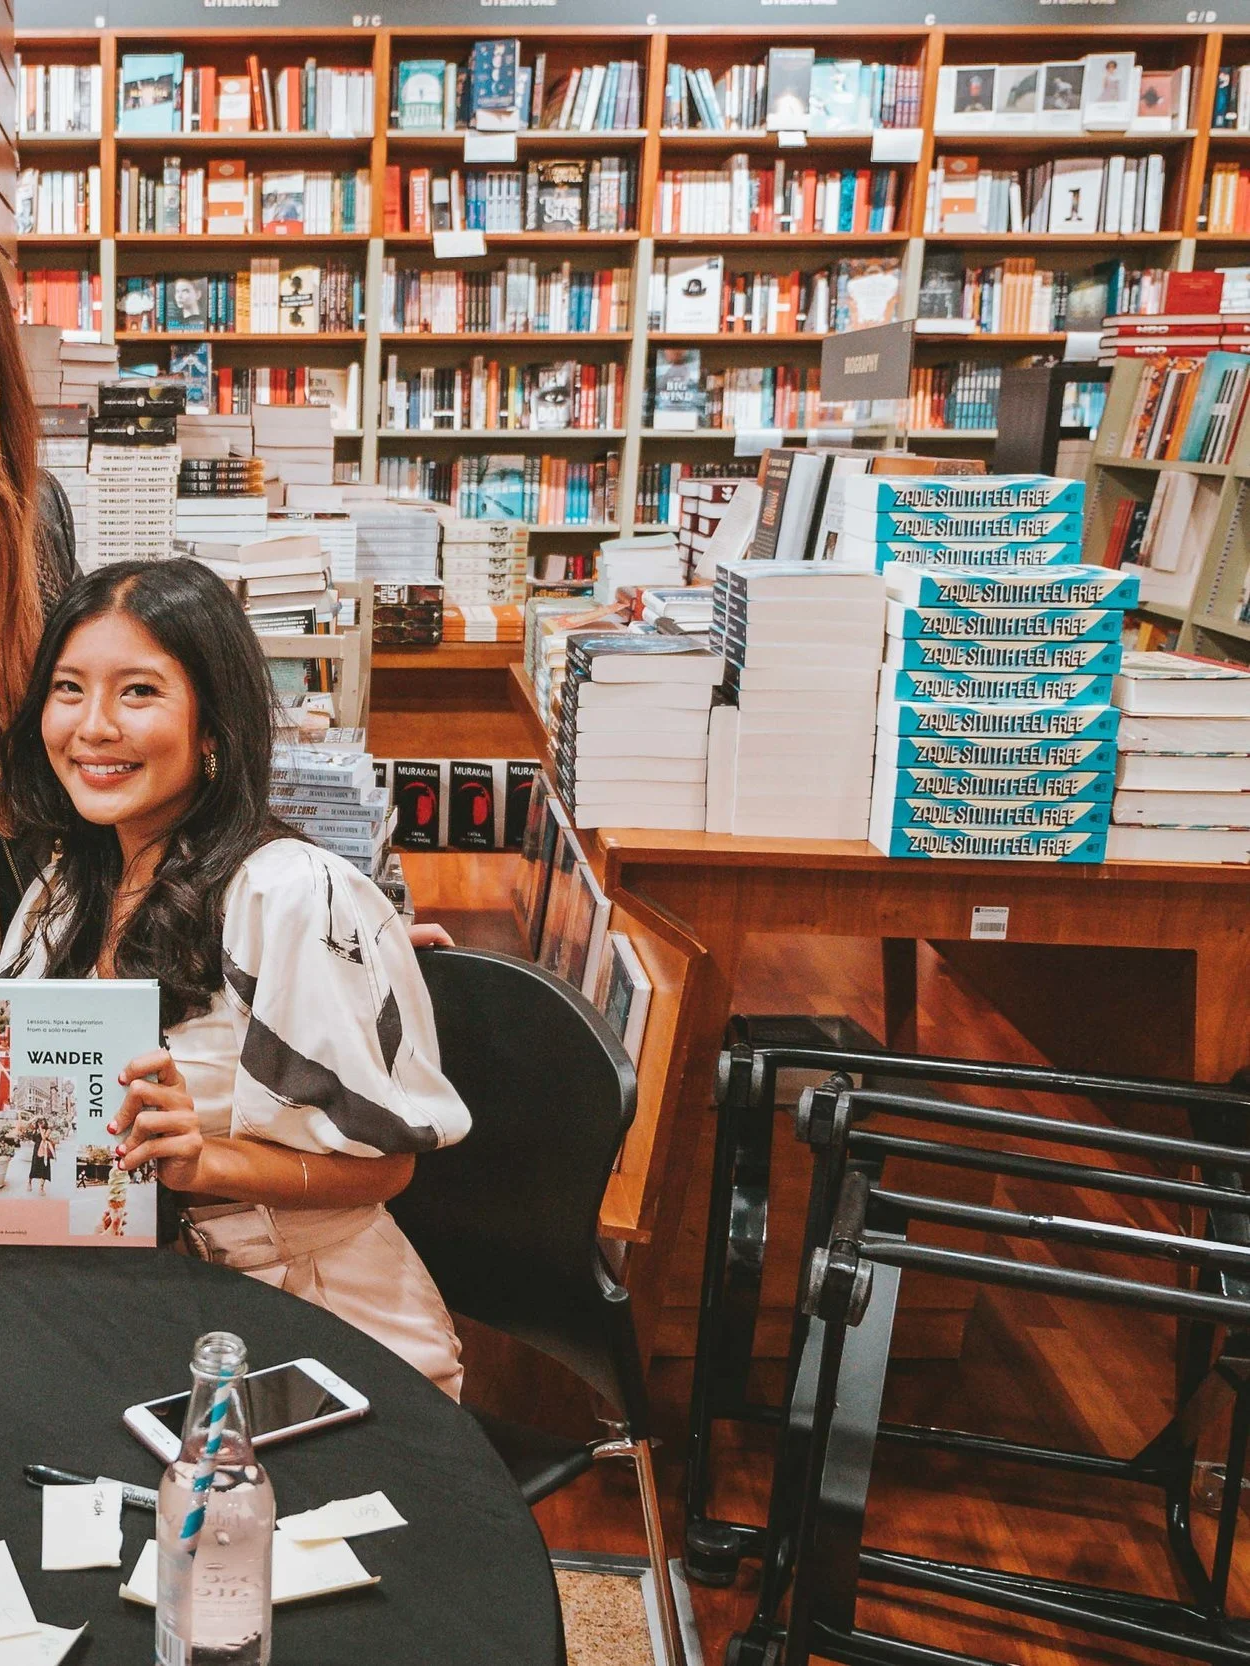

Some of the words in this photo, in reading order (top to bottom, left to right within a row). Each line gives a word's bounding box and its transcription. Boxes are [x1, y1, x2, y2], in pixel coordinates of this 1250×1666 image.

[894, 489, 935, 507] ZADIE
[935, 489, 982, 507] SMITH
[984, 489, 1015, 507] FEEL
[1016, 489, 1051, 507] FREE
[894, 519, 934, 536] ZADIE
[935, 519, 982, 536] SMITH
[982, 519, 1014, 536] FEEL
[1016, 519, 1051, 536] FREE
[894, 549, 933, 563] ZADIE
[934, 549, 980, 563] SMITH
[981, 549, 1011, 565] FEEL
[1014, 549, 1047, 565] FREE
[937, 584, 981, 602] ZADIE
[982, 584, 1032, 602] SMITH
[1033, 585, 1066, 603] FEEL
[1068, 585, 1104, 603] FREE
[921, 616, 964, 635] ZADIE
[965, 616, 1014, 635] SMITH
[1016, 617, 1049, 636] FEEL
[1051, 617, 1087, 636] FREE
[921, 648, 964, 665] ZADIE
[965, 648, 1014, 665] SMITH
[1016, 649, 1050, 667] FEEL
[1051, 649, 1087, 667] FREE
[913, 680, 956, 698] ZADIE
[957, 680, 1005, 698] SMITH
[1007, 681, 1041, 699] FEEL
[1042, 681, 1077, 699] FREE
[917, 713, 960, 732] ZADIE
[961, 713, 1011, 732] SMITH
[1011, 714, 1046, 733] FEEL
[1047, 714, 1082, 733] FREE
[916, 745, 958, 764] ZADIE
[959, 745, 1009, 764] SMITH
[1010, 746, 1043, 765] FEEL
[1045, 746, 1082, 765] FREE
[398, 766, 439, 778] MURAKAMI
[454, 766, 492, 778] MURAKAMI
[510, 766, 535, 777] MURA
[914, 777, 957, 795] ZADIE
[958, 777, 1008, 795] SMITH
[1008, 778, 1042, 796] FEEL
[1043, 778, 1079, 796] FREE
[911, 806, 954, 824] ZADIE
[954, 806, 1004, 824] SMITH
[1004, 807, 1037, 825] FEEL
[1038, 807, 1075, 825] FREE
[908, 835, 951, 853] ZADIE
[952, 835, 1000, 853] SMITH
[1000, 838, 1034, 856] FEEL
[1036, 838, 1072, 856] FREE
[27, 1051, 103, 1065] WANDER
[89, 1074, 103, 1117] LOVE
